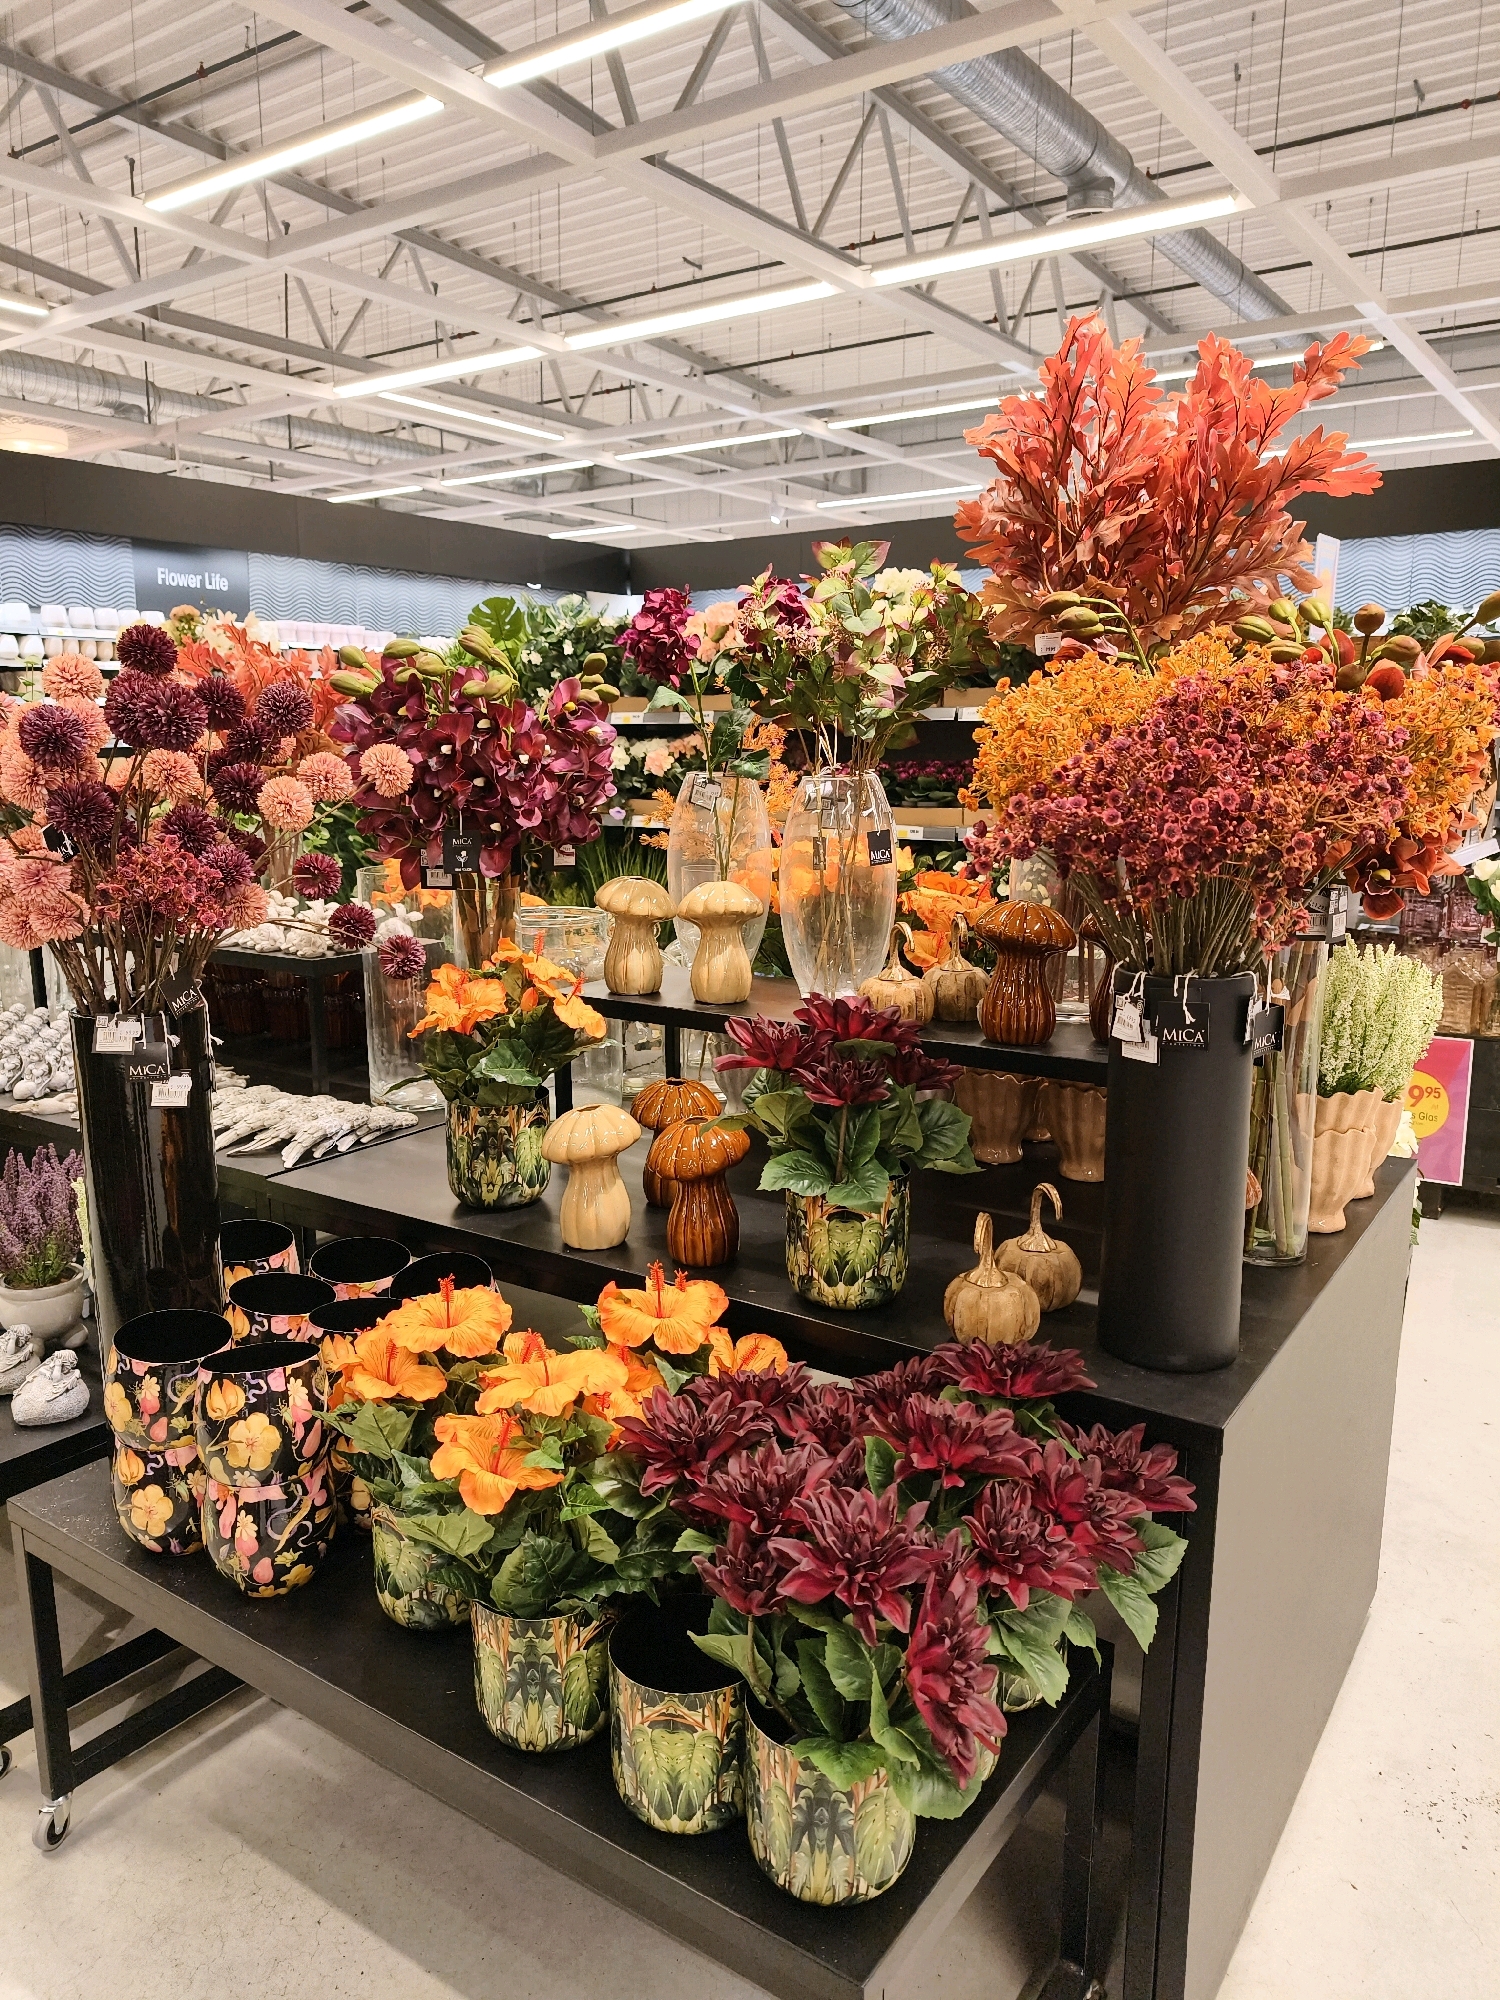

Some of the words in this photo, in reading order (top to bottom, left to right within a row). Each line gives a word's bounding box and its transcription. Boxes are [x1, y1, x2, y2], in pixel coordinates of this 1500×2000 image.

[157, 567, 202, 589] Flower
[205, 572, 229, 592] Life
[171, 987, 198, 1012] MICA
[1162, 1027, 1205, 1043] MICA
[129, 1063, 166, 1076] MICA
[1418, 1111, 1439, 1122] Glas
